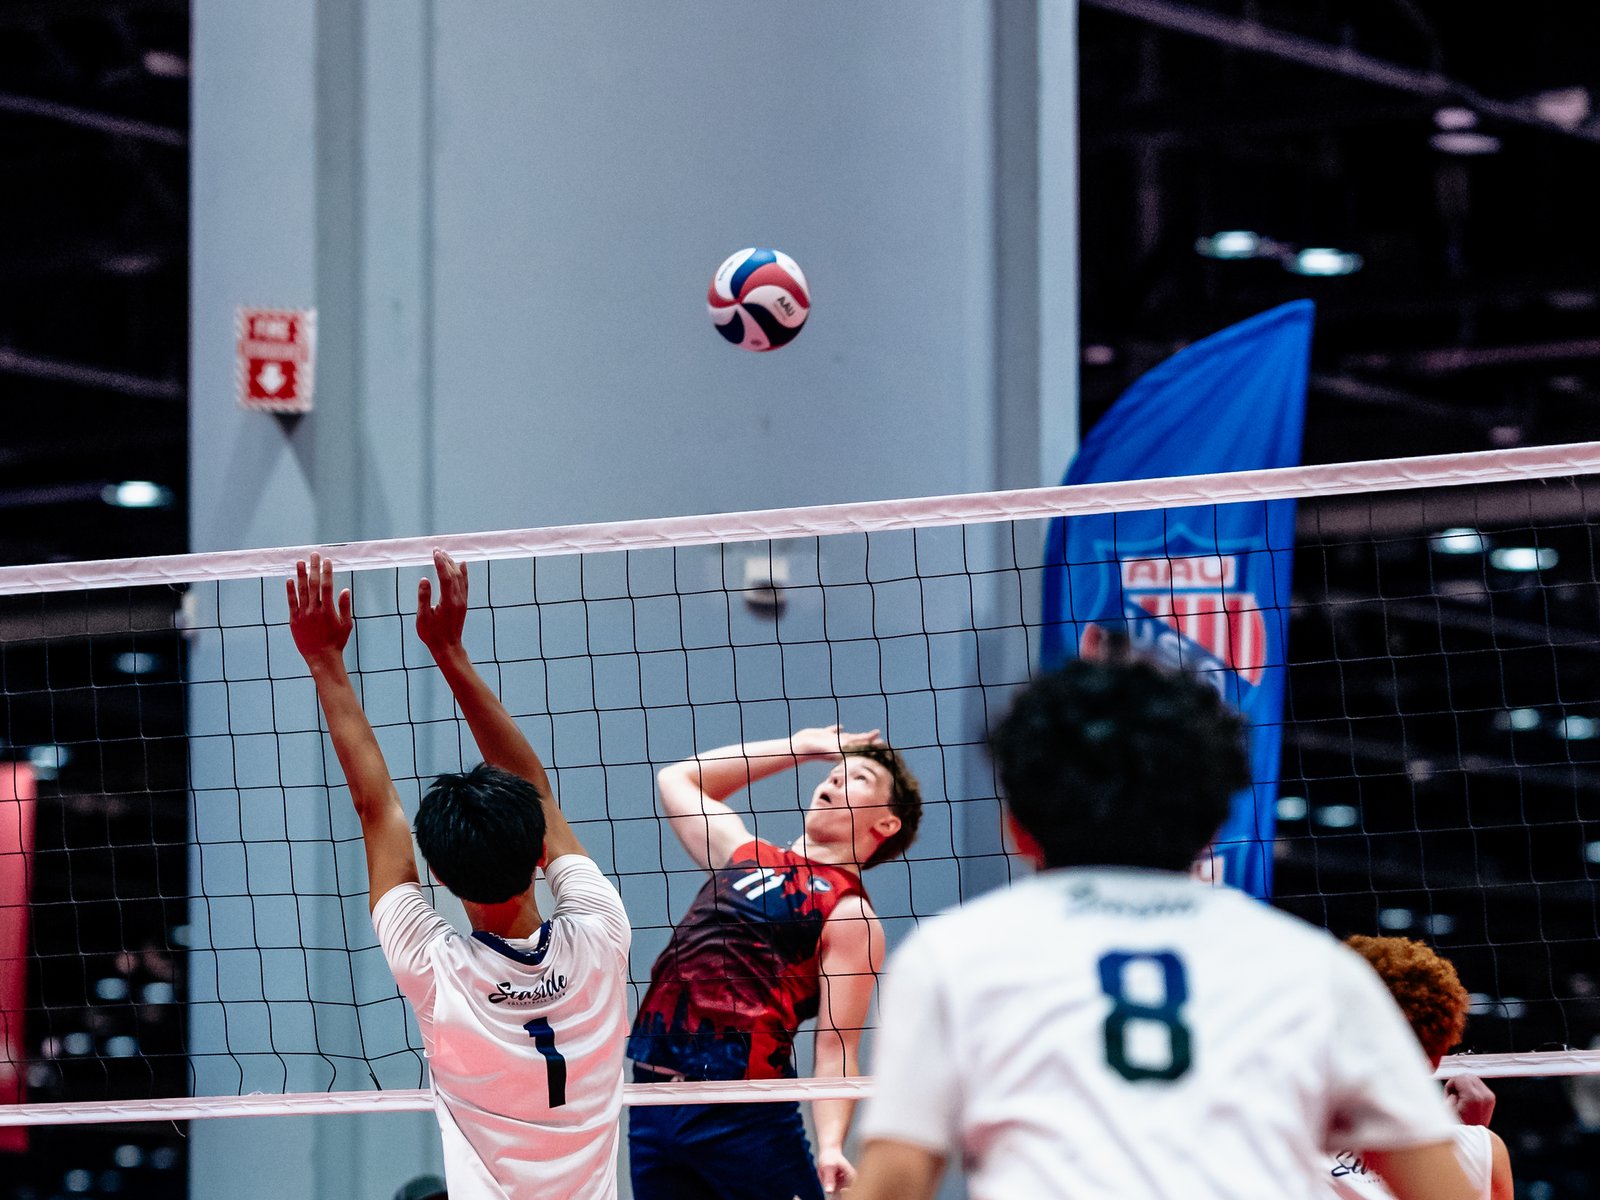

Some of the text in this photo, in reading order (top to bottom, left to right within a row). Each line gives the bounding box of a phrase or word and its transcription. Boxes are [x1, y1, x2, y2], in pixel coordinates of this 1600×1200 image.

[778, 296, 796, 317] AAU
[1128, 558, 1228, 584] AAU
[732, 867, 786, 901] 11
[488, 968, 567, 1004] Seaside
[1097, 949, 1192, 1082] 8
[523, 1016, 567, 1109] 1
